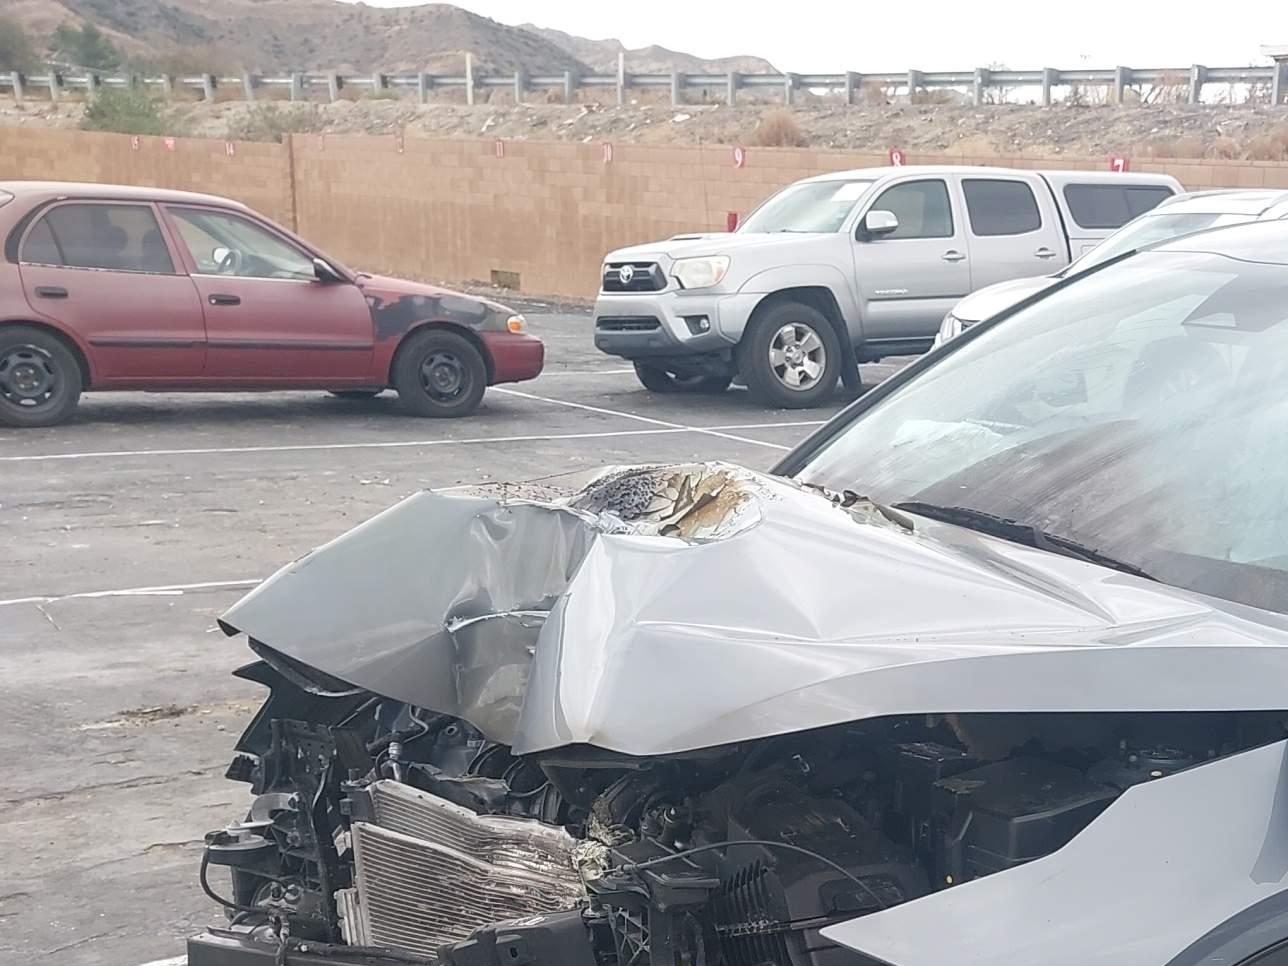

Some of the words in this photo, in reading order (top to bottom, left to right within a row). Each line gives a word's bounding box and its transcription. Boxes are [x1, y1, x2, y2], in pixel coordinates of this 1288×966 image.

[602, 143, 613, 161] 10
[734, 147, 743, 168] 9
[892, 151, 901, 167] 8
[1113, 159, 1125, 173] 7
